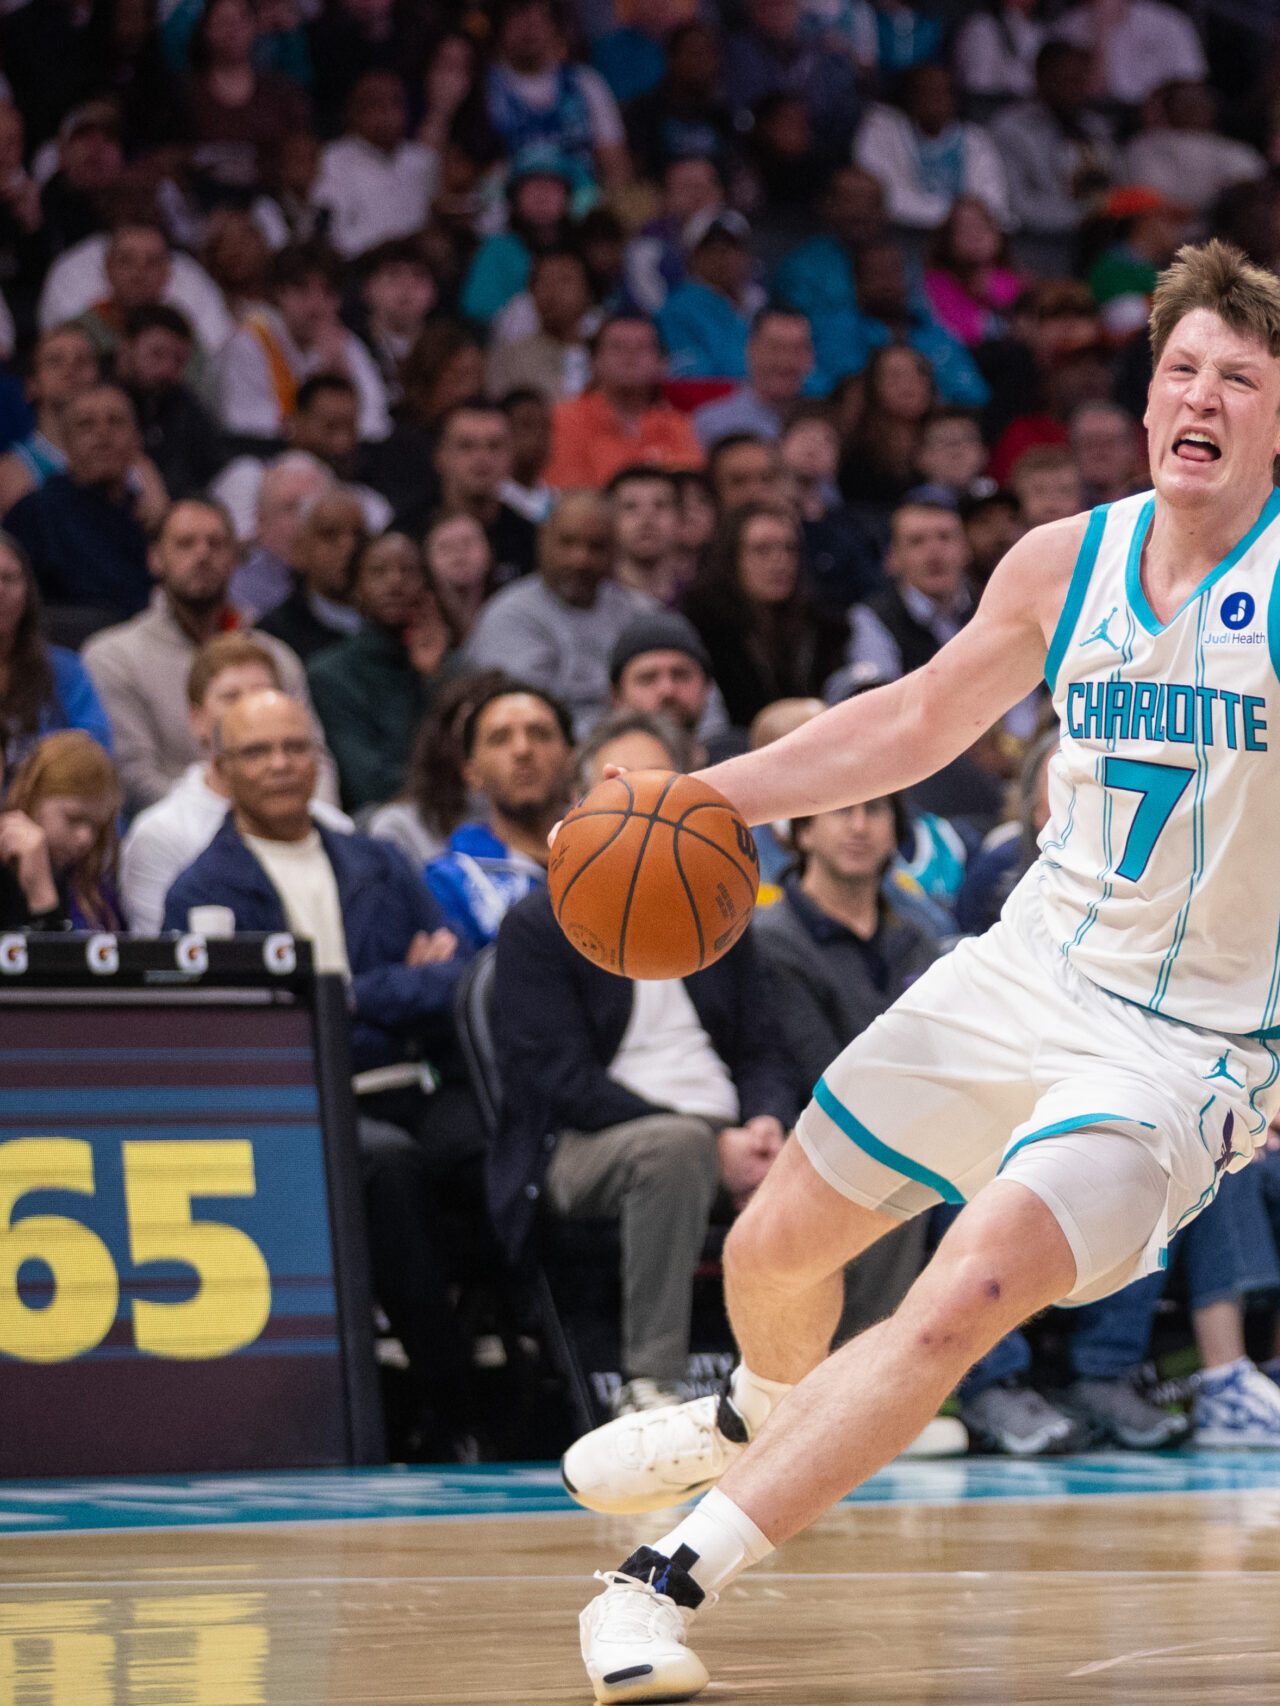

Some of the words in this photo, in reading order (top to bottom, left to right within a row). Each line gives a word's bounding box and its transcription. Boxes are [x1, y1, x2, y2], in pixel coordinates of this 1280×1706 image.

[1204, 633, 1230, 644] Judi
[1232, 631, 1266, 644] Health
[1067, 681, 1268, 752] CHARLOTTE
[1104, 756, 1197, 883] 7
[86, 932, 119, 975] G
[263, 931, 297, 975] G
[0, 1136, 272, 1364] 65
